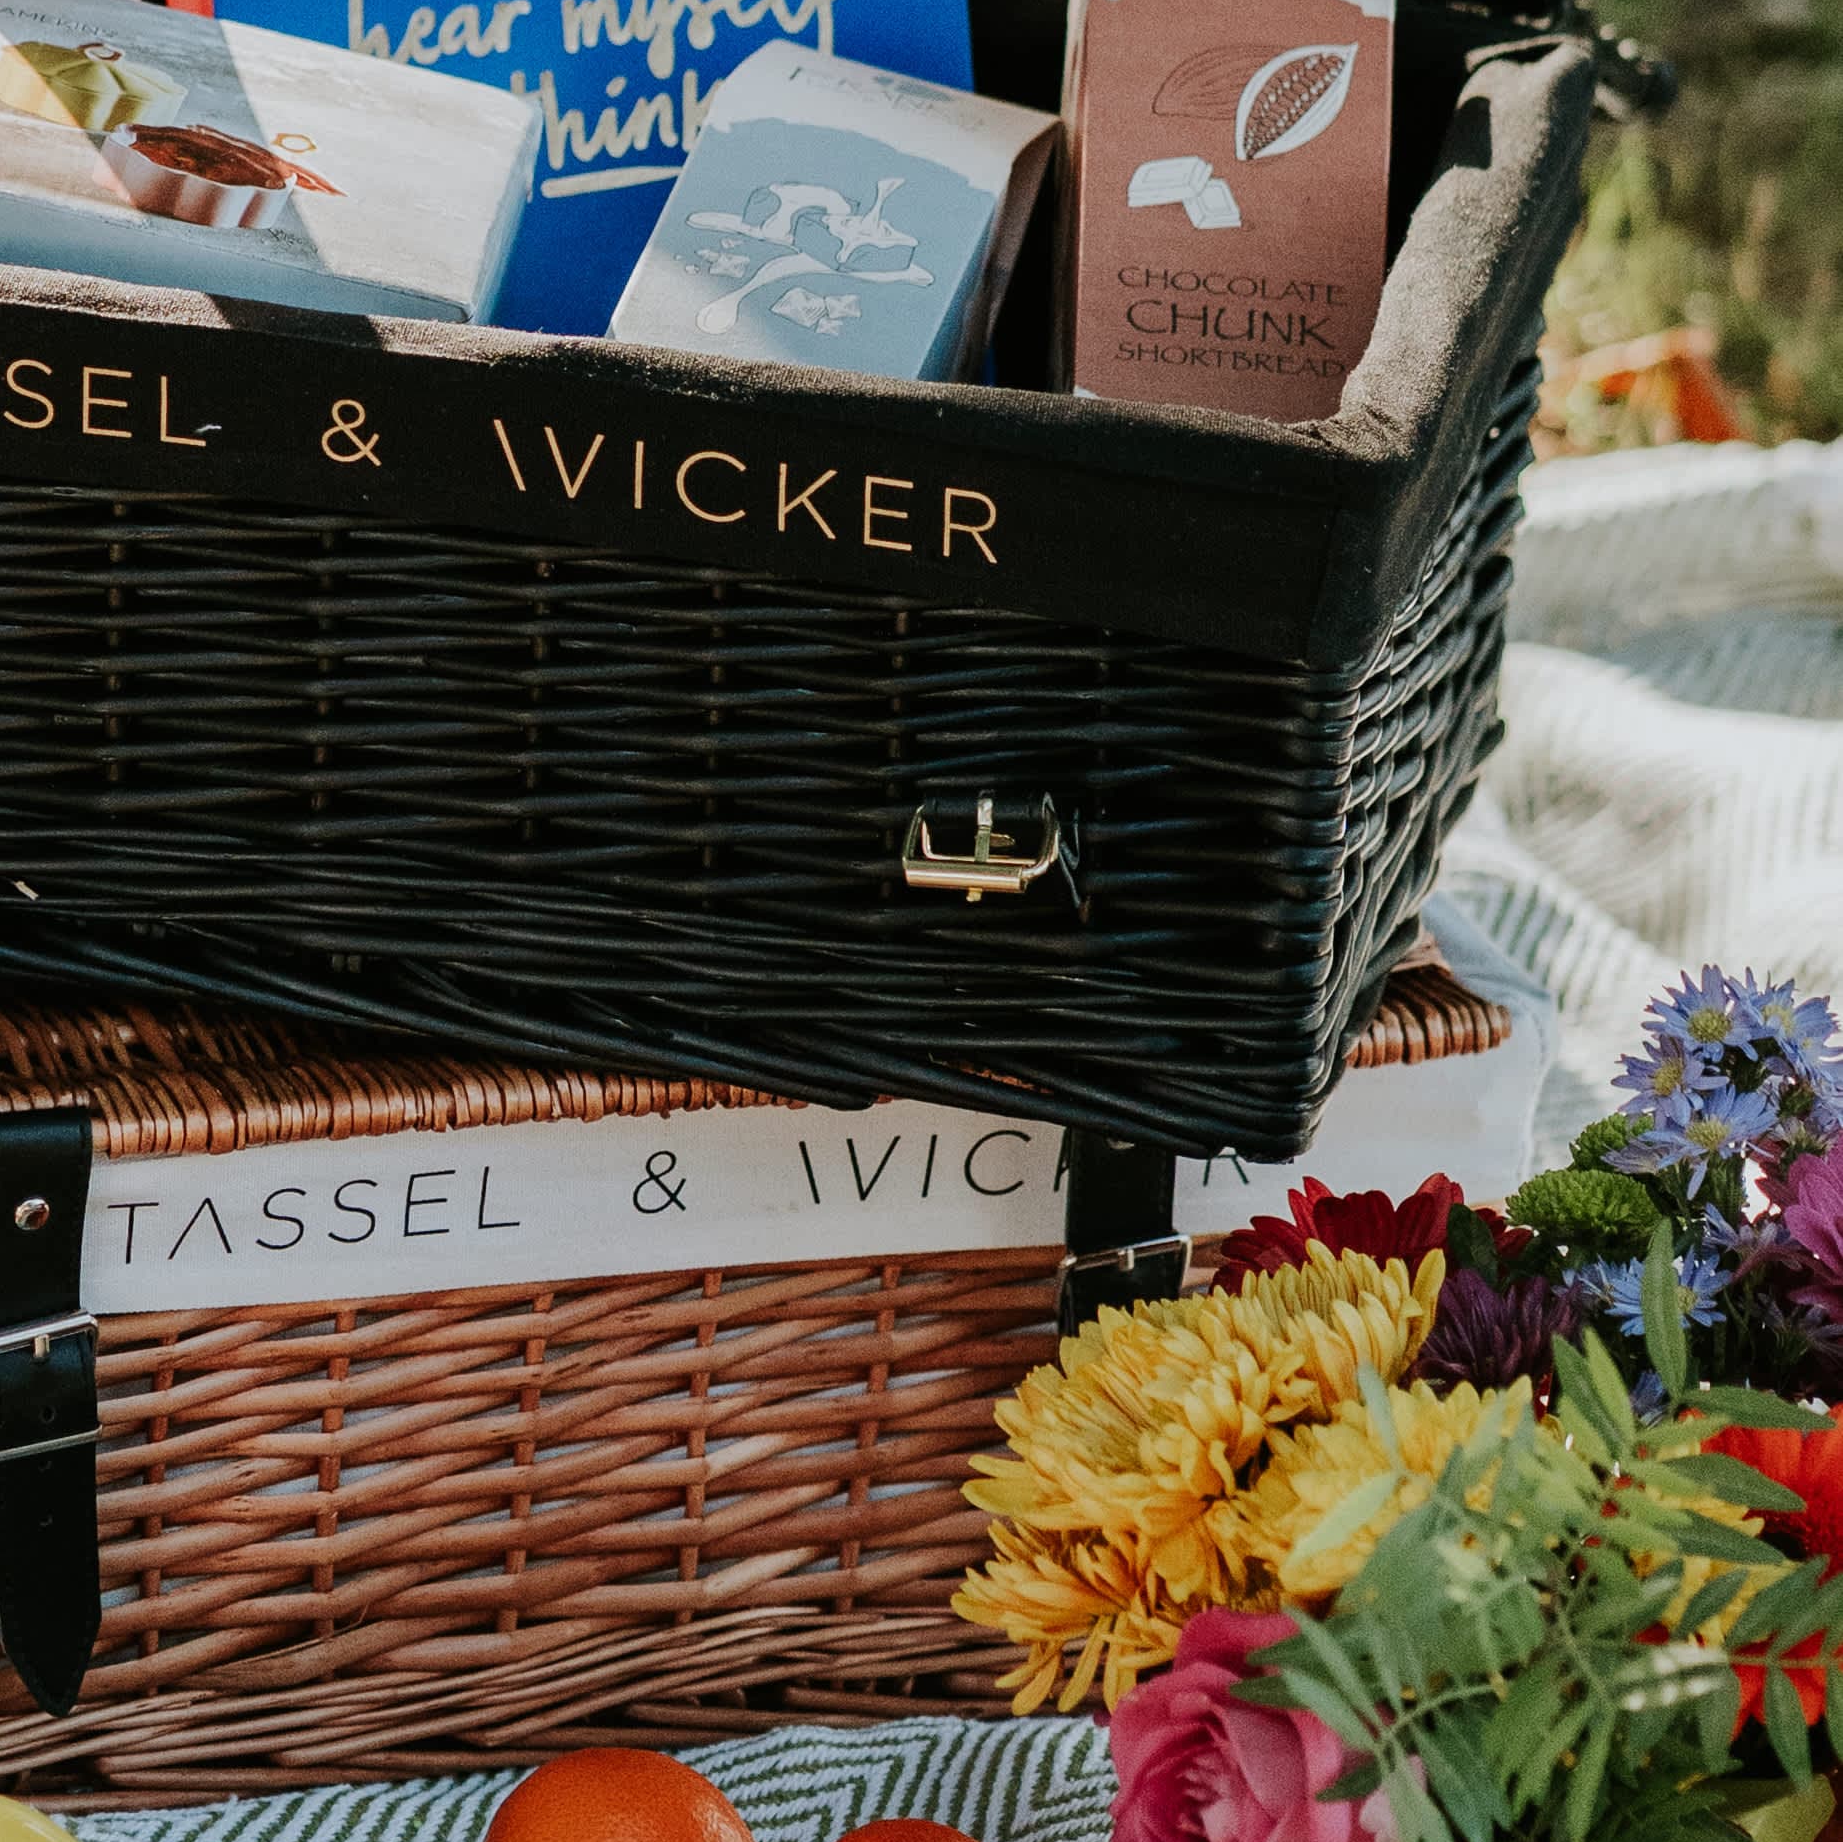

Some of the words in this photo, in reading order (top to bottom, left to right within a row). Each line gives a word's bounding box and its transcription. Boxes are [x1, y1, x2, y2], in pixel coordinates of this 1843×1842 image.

[1117, 266, 1348, 306] CHOCOLATE
[1126, 299, 1335, 350] CHUNK
[1115, 341, 1347, 377] SHORTBREAD
[321, 399, 382, 467] &
[493, 419, 998, 564] WICKER
[107, 1165, 521, 1265] TASSEL
[632, 1150, 687, 1214] &
[798, 1127, 1249, 1204] WIC
